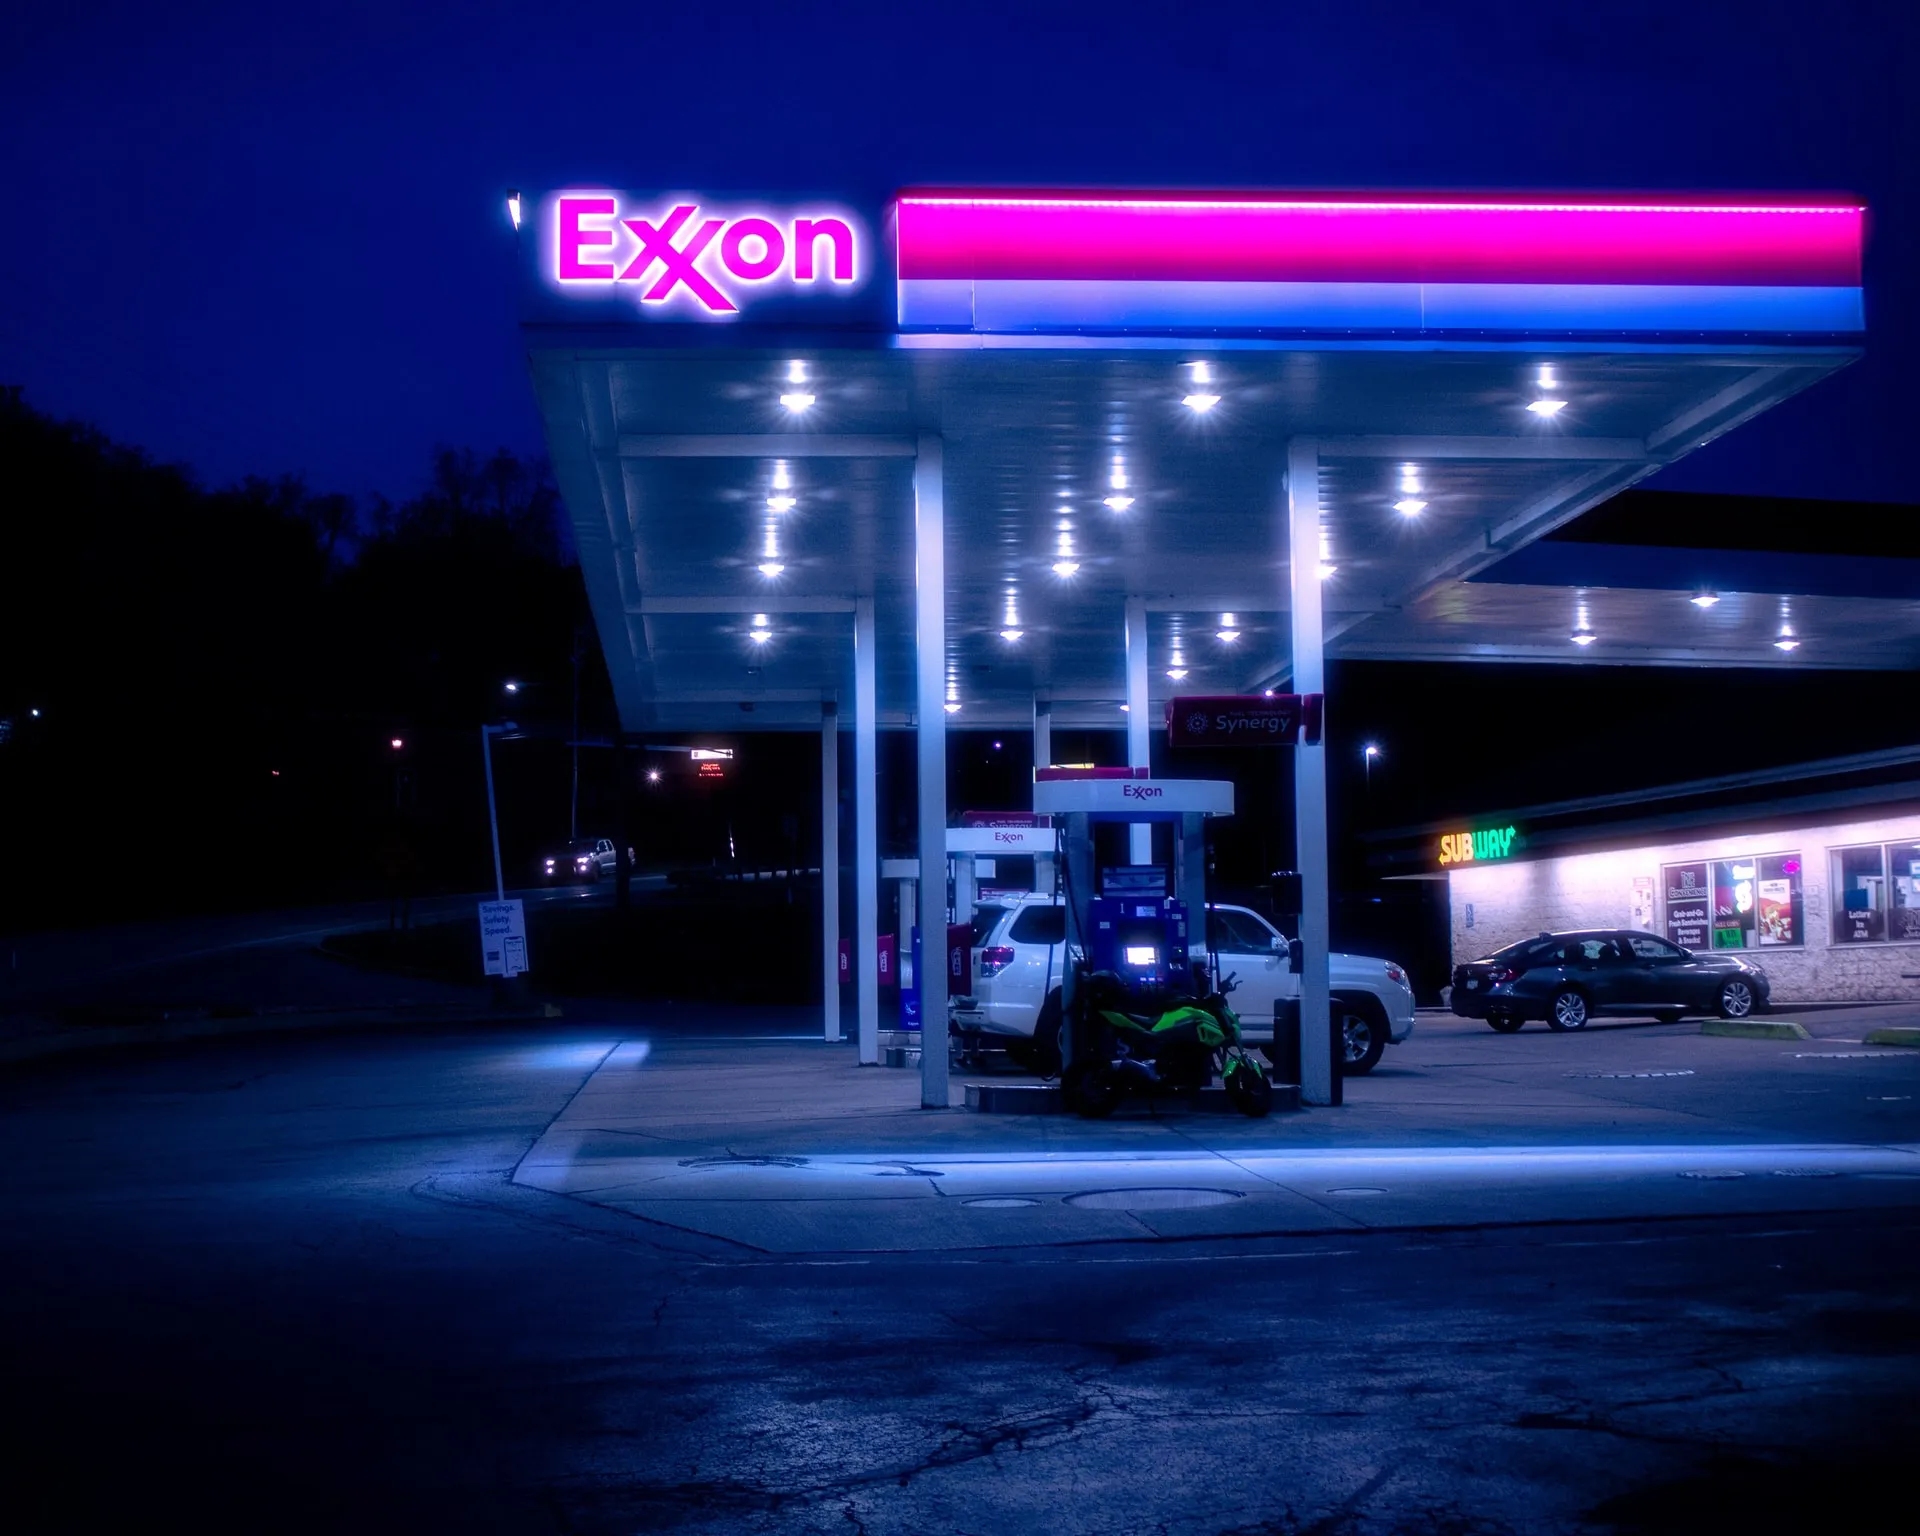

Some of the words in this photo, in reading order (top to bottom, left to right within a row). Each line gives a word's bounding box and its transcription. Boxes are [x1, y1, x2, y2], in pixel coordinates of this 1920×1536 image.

[558, 197, 856, 315] Exxon
[1215, 714, 1291, 734] Synergy
[1123, 784, 1163, 801] Exxon
[994, 832, 1024, 844] Exxon
[1438, 825, 1516, 866] SUBWAY
[1848, 910, 1871, 919] Lottery
